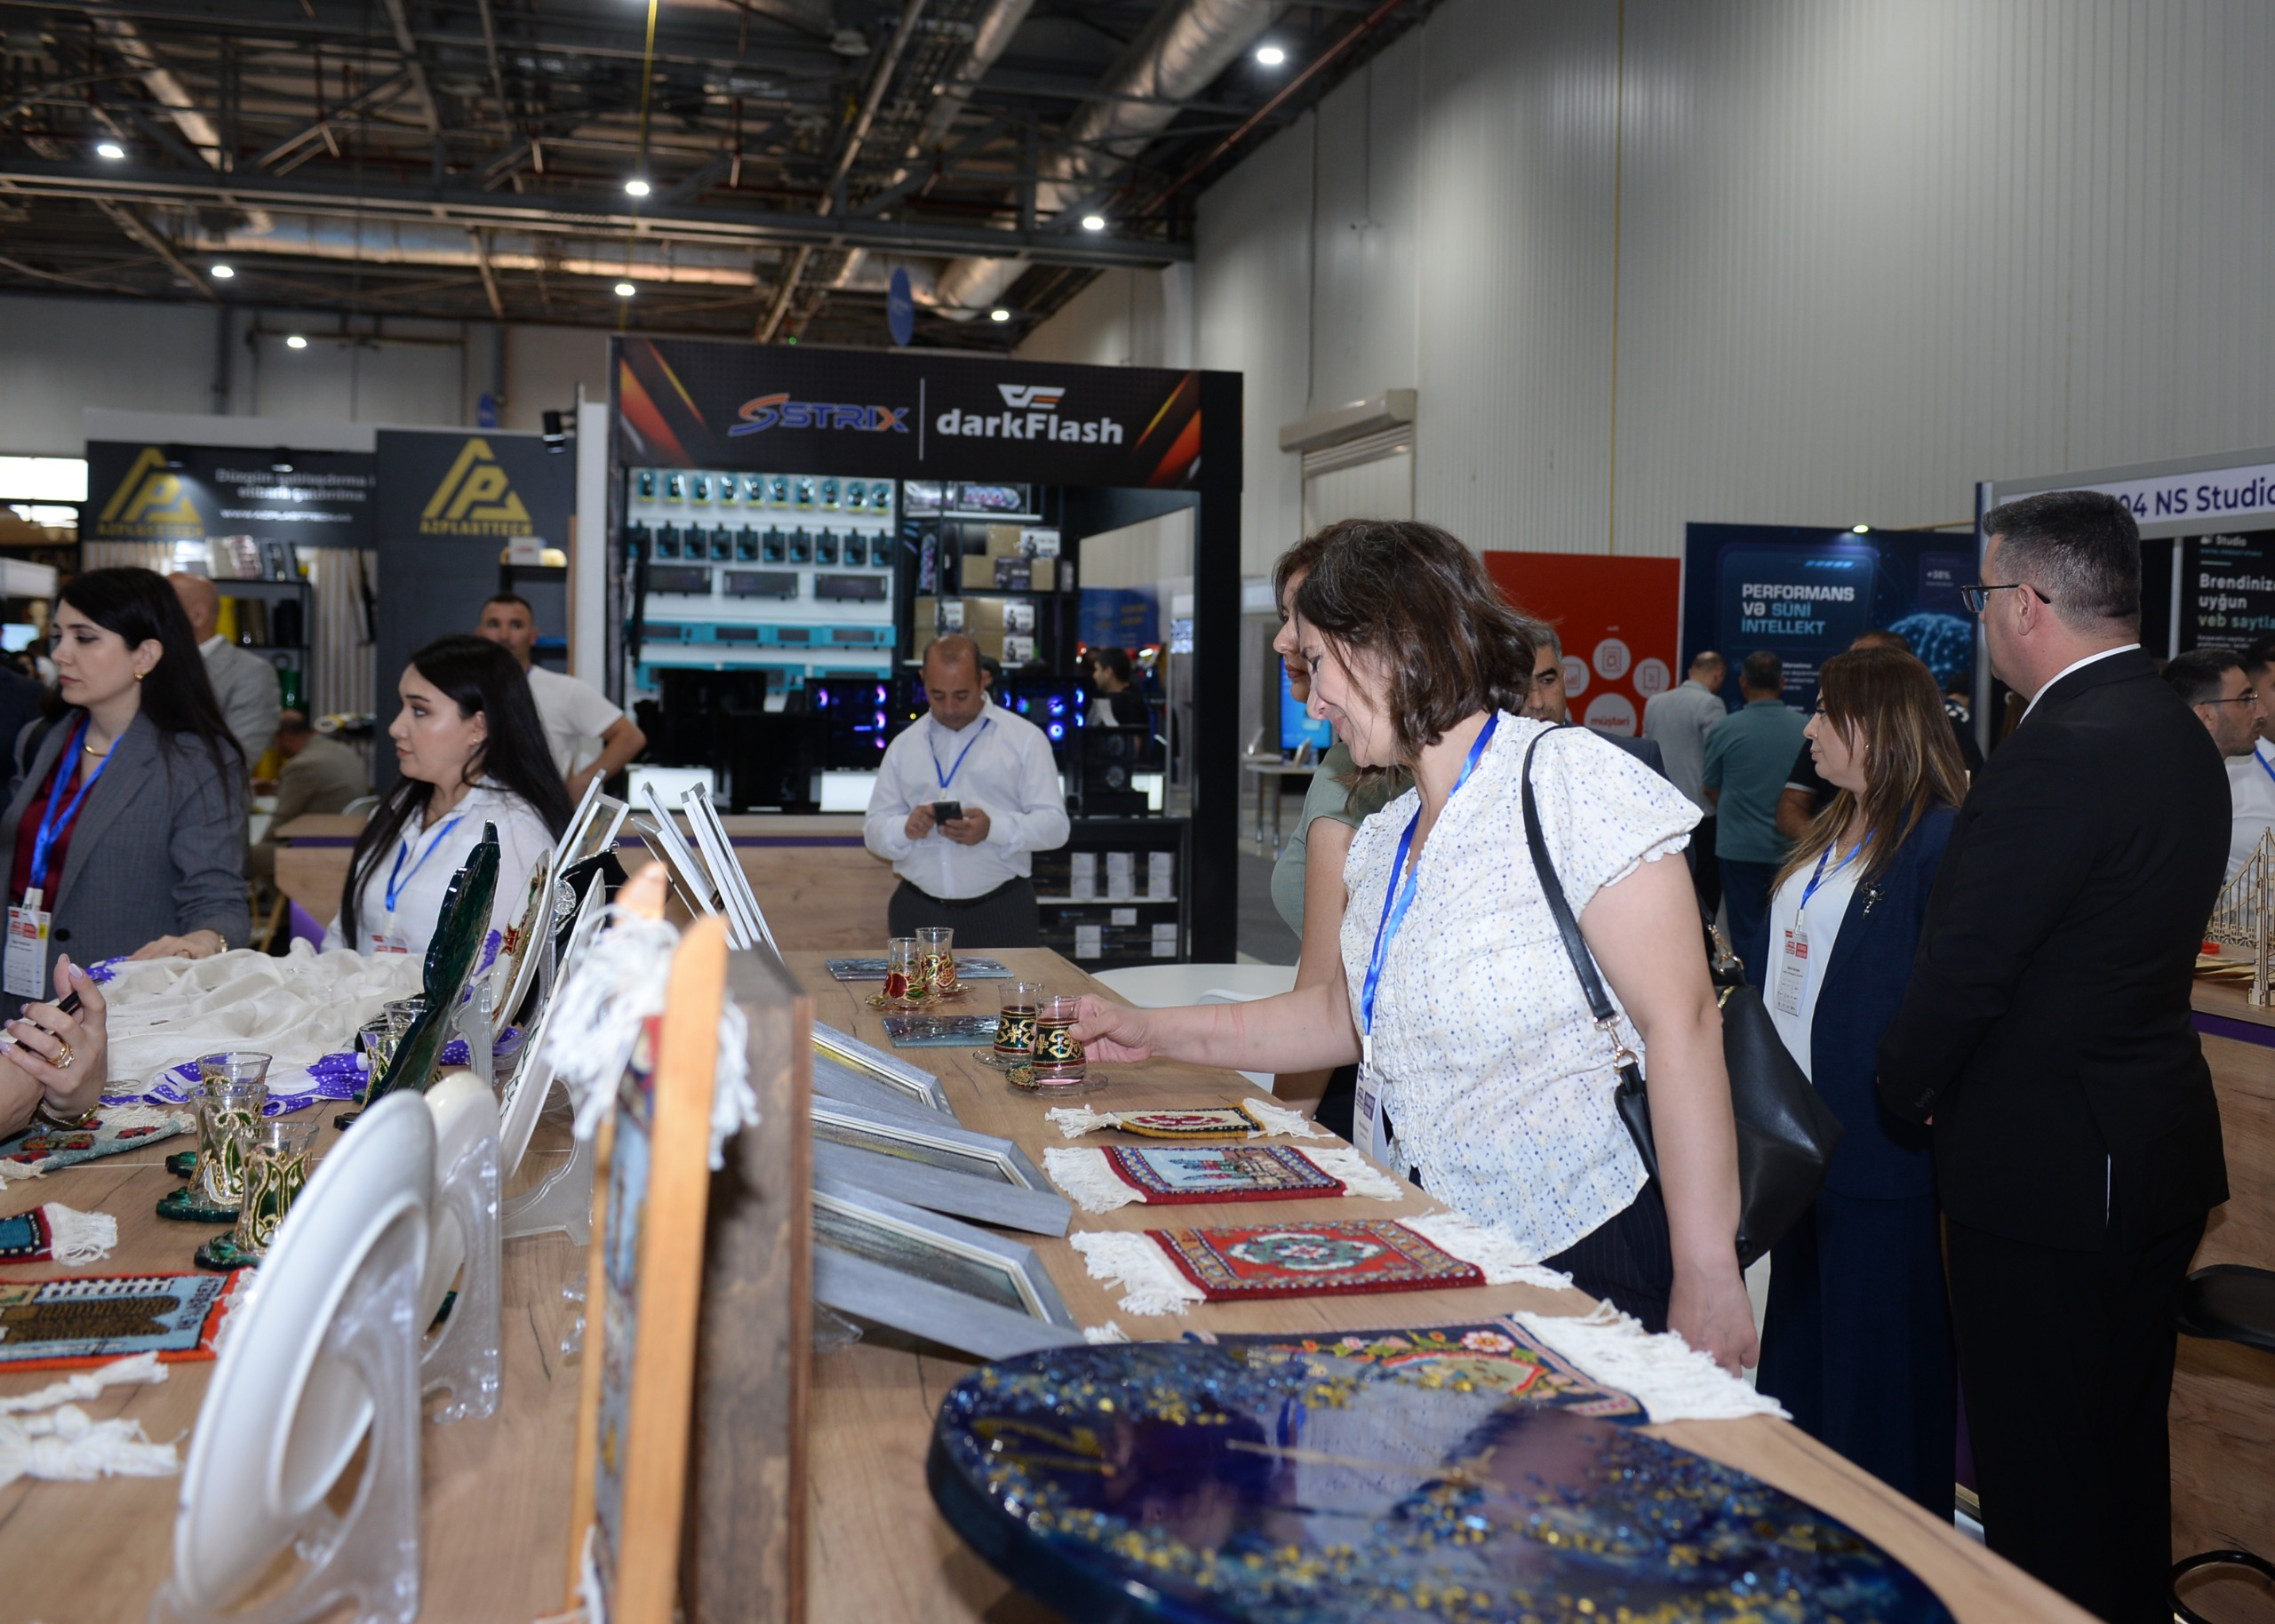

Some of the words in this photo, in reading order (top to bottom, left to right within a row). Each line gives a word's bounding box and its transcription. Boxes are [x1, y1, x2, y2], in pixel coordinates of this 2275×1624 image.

[936, 408, 1124, 444] darkFlash
[2155, 488, 2188, 516] NS
[2199, 573, 2275, 592] Brendiniz
[1742, 584, 1856, 601] PERFORMANS
[1771, 601, 1811, 617] SÜNİ
[2199, 593, 2247, 611] uyğun
[1742, 616, 1826, 635] İNTELLEKT
[2199, 613, 2227, 627] veb
